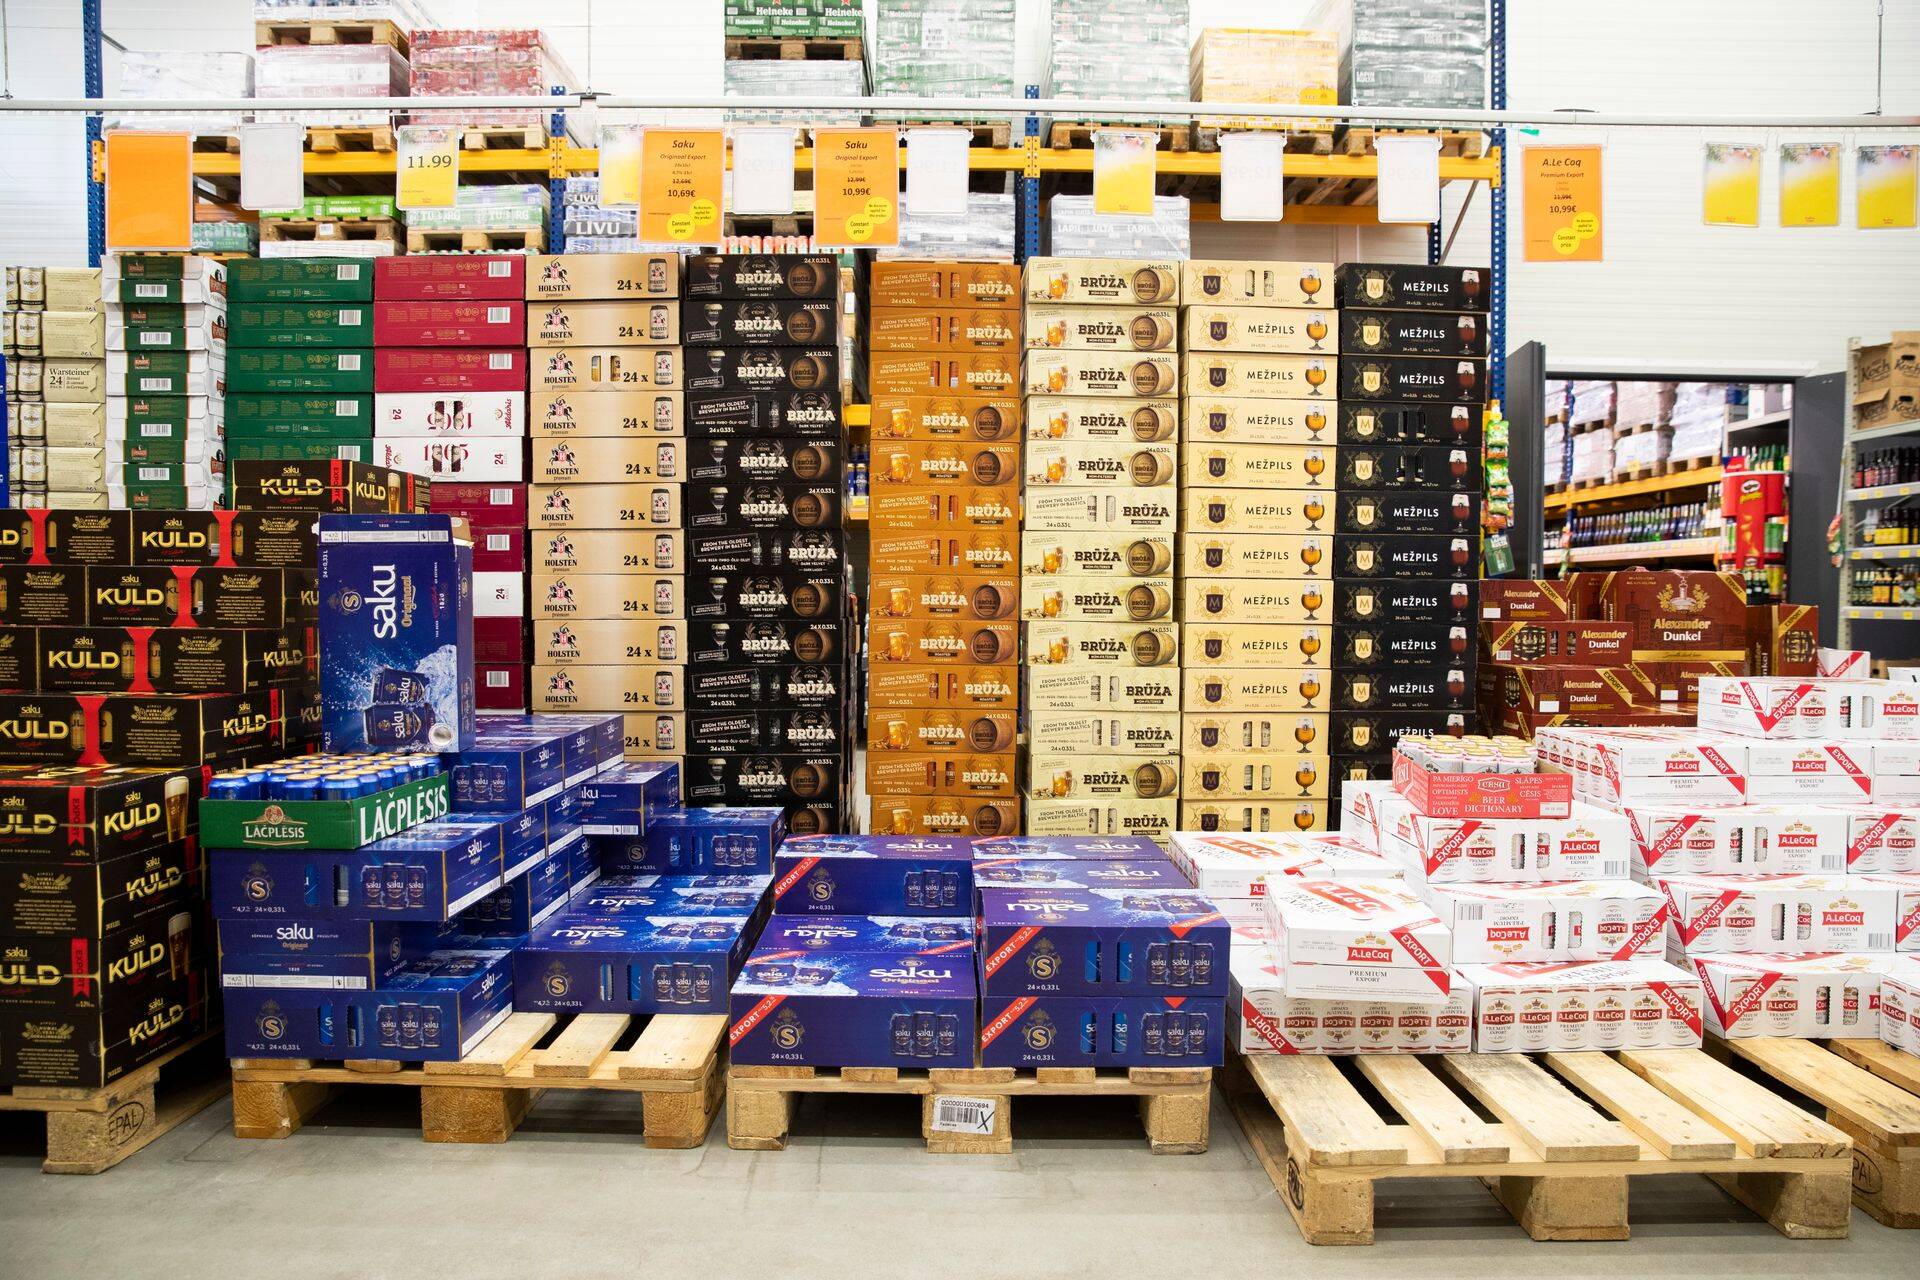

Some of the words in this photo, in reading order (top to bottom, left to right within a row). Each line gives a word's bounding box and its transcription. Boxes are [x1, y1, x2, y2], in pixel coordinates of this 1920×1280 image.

[672, 139, 695, 149] Saku
[845, 140, 868, 150] Saku
[408, 155, 452, 169] 11.99
[1564, 158, 1582, 168] Coq
[667, 189, 696, 199] 10,69€
[842, 187, 872, 197] 10,99€
[1549, 205, 1577, 214] 10,99€
[538, 284, 571, 292] HOLSTEN
[616, 280, 632, 291] 24
[634, 282, 643, 290] x
[1403, 280, 1449, 293] MEŽPILS
[540, 331, 573, 339] HOLSTEN
[618, 326, 634, 337] 24
[636, 328, 644, 337] x
[1248, 322, 1295, 335] MEŽPILS
[1400, 326, 1445, 339] MEŽPILS
[49, 368, 91, 376] Warsteiner
[622, 371, 638, 383] 24
[640, 374, 649, 382] x
[1247, 368, 1294, 381] MEŽPILS
[1399, 372, 1445, 385] MEŽPILS
[50, 376, 63, 385] 24
[544, 376, 577, 384] HOLSTEN
[543, 421, 577, 430] HOLSTEN
[622, 417, 638, 429] 24
[640, 420, 649, 429] x
[545, 467, 579, 475] HOLSTEN
[625, 463, 641, 475] 24
[643, 466, 651, 475] x
[1246, 458, 1292, 471] MEŽPILS
[260, 478, 324, 496] KULD
[355, 481, 387, 502] KULD
[541, 513, 574, 521] HOLSTEN
[619, 509, 635, 520] 24
[637, 512, 646, 520] x
[1393, 506, 1439, 519] MEŽPILS
[141, 531, 207, 548] KULD
[1243, 548, 1289, 561] MEŽPILS
[544, 559, 578, 567] HOLSTEN
[96, 588, 165, 606] KULD
[1503, 589, 1540, 599] Alexander
[364, 563, 397, 640] saku
[544, 604, 577, 612] HOLSTEN
[1392, 595, 1438, 608] MEŽPILS
[1510, 602, 1535, 610] Dunkel
[1653, 618, 1712, 630] Alexander
[1581, 630, 1628, 640] Alexander
[1663, 631, 1702, 641] Dunkel
[1242, 639, 1288, 652] MEŽPILS
[1588, 640, 1620, 649] Dunkel
[48, 651, 121, 669] KULD
[264, 649, 303, 668] KULD
[547, 649, 580, 658] HOLSTEN
[1242, 683, 1288, 695] MEŽPILS
[1389, 682, 1434, 695] MEŽPILS
[1563, 680, 1604, 690] Alexander
[545, 695, 578, 703] HOLSTEN
[1570, 694, 1597, 704] Dunkel
[1772, 691, 1802, 721] EXPORT
[223, 713, 267, 738] KULD
[1667, 761, 1698, 772] A.LeCoq
[1705, 748, 1730, 774] EXPORT
[1794, 760, 1825, 771] A.LeCoq
[1831, 748, 1856, 774] EXPORT
[1482, 796, 1505, 804] BEER
[1432, 807, 1459, 815] LOVE
[1464, 804, 1524, 813] DICTIONARY
[0, 813, 58, 835] ULD
[103, 803, 162, 837] KULD
[1656, 821, 1688, 854] EXPORT
[1781, 834, 1815, 847] A.LeCoq
[1857, 821, 1887, 852] EXPORT
[885, 841, 953, 850] saku
[1435, 831, 1467, 862] EXPORT
[1562, 842, 1598, 853] A.LeCoq
[1086, 868, 1163, 877] saku
[126, 866, 183, 902] KULD
[1693, 900, 1725, 932] EXPORT
[1826, 913, 1861, 925] A.LeCoq
[276, 923, 314, 940] saku
[1628, 917, 1659, 952] EXPORT
[1350, 949, 1390, 962] A.LeCoq
[1400, 934, 1432, 965] EXPORT
[108, 942, 166, 984] KULD
[985, 941, 1015, 973] EXPORT
[0, 964, 63, 986] ULD
[869, 959, 952, 979] saku
[1661, 988, 1695, 1022] EXPORT
[1732, 983, 1766, 1015] EXPORT
[129, 1003, 185, 1047] KULD
[981, 1010, 1012, 1042] EXPORT
[1252, 1014, 1284, 1049] EXPORT
